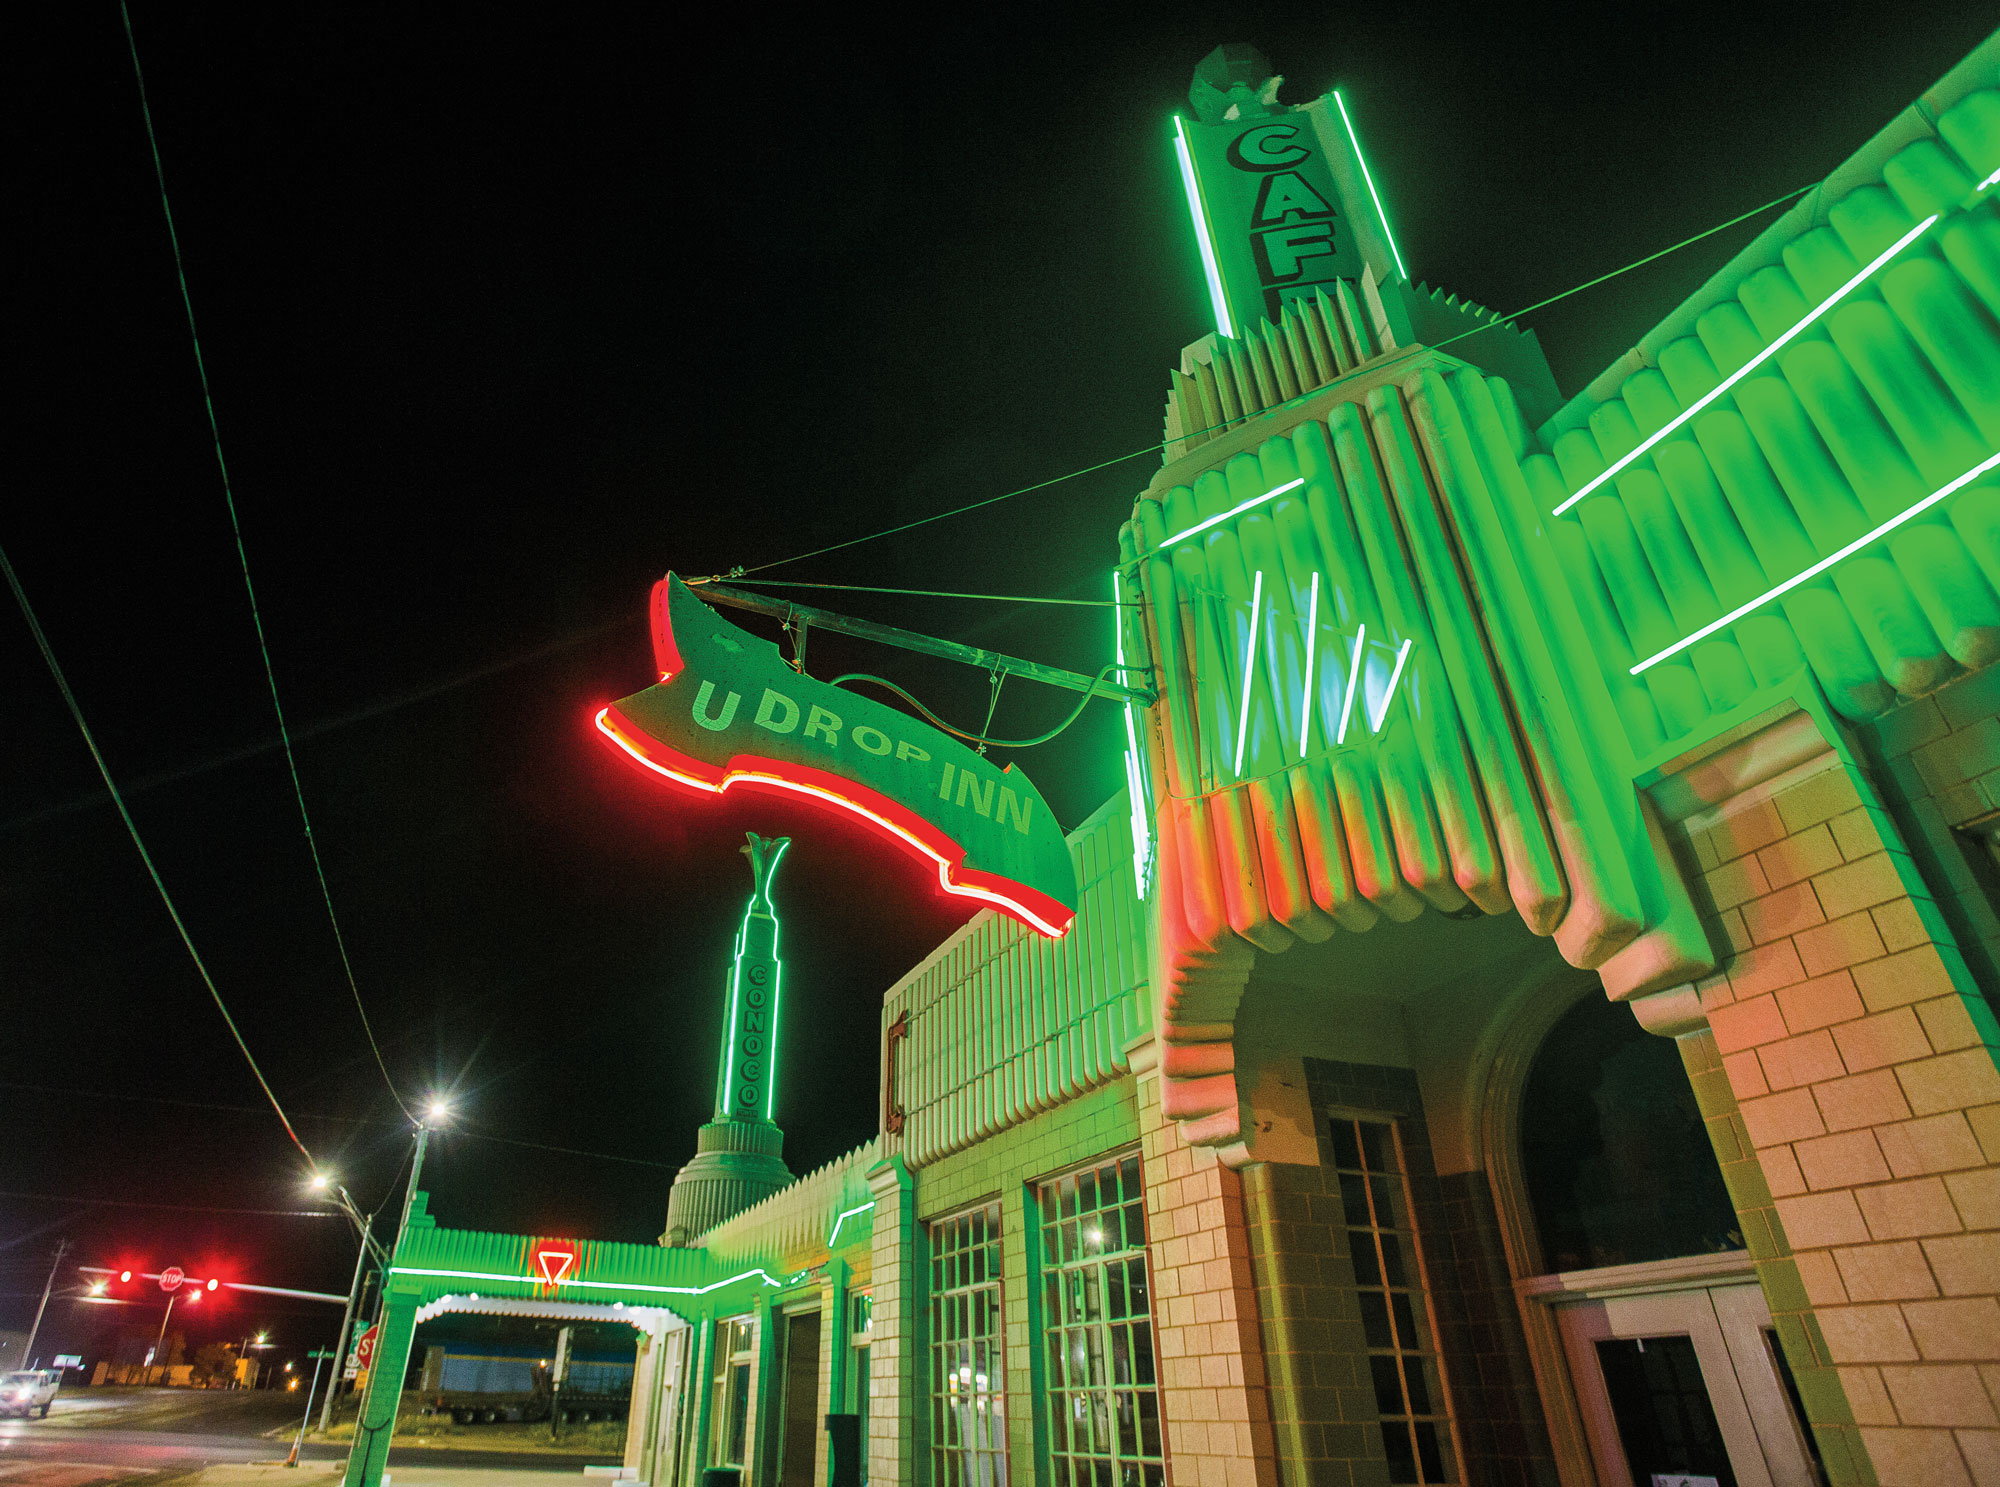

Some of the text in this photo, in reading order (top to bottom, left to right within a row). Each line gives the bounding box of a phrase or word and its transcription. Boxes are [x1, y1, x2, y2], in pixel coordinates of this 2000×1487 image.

[692, 680, 1033, 836] U DROP INN
[738, 965, 767, 1108] CONOCO
[161, 1274, 182, 1284] STOP
